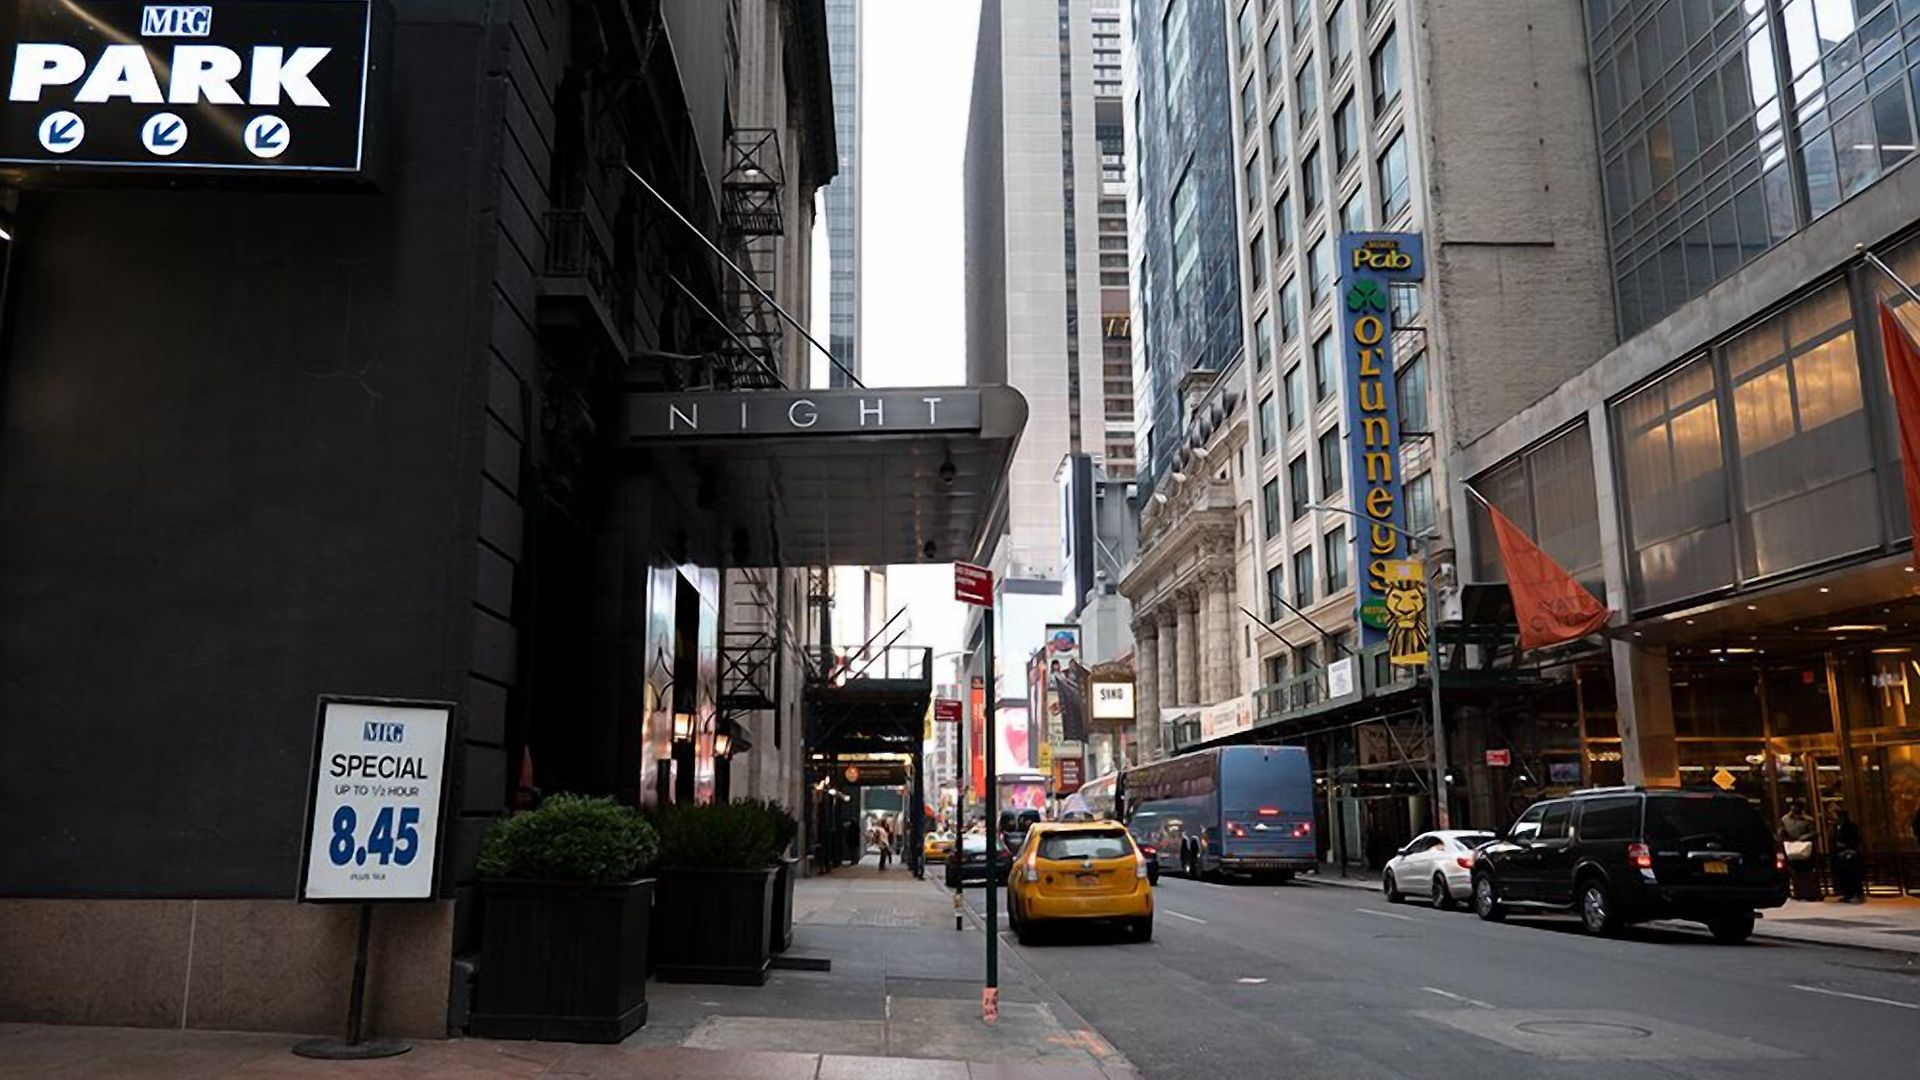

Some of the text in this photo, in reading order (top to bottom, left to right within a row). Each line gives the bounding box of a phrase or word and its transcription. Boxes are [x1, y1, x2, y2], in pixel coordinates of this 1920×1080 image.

[9, 43, 332, 107] PARK
[1353, 249, 1411, 269] Pub
[669, 397, 943, 431] NIGHT
[329, 754, 428, 780] SPECIAL
[335, 785, 350, 796] UP
[354, 785, 369, 796] TO
[388, 786, 419, 797] HOUR
[329, 805, 420, 867] 8.45
